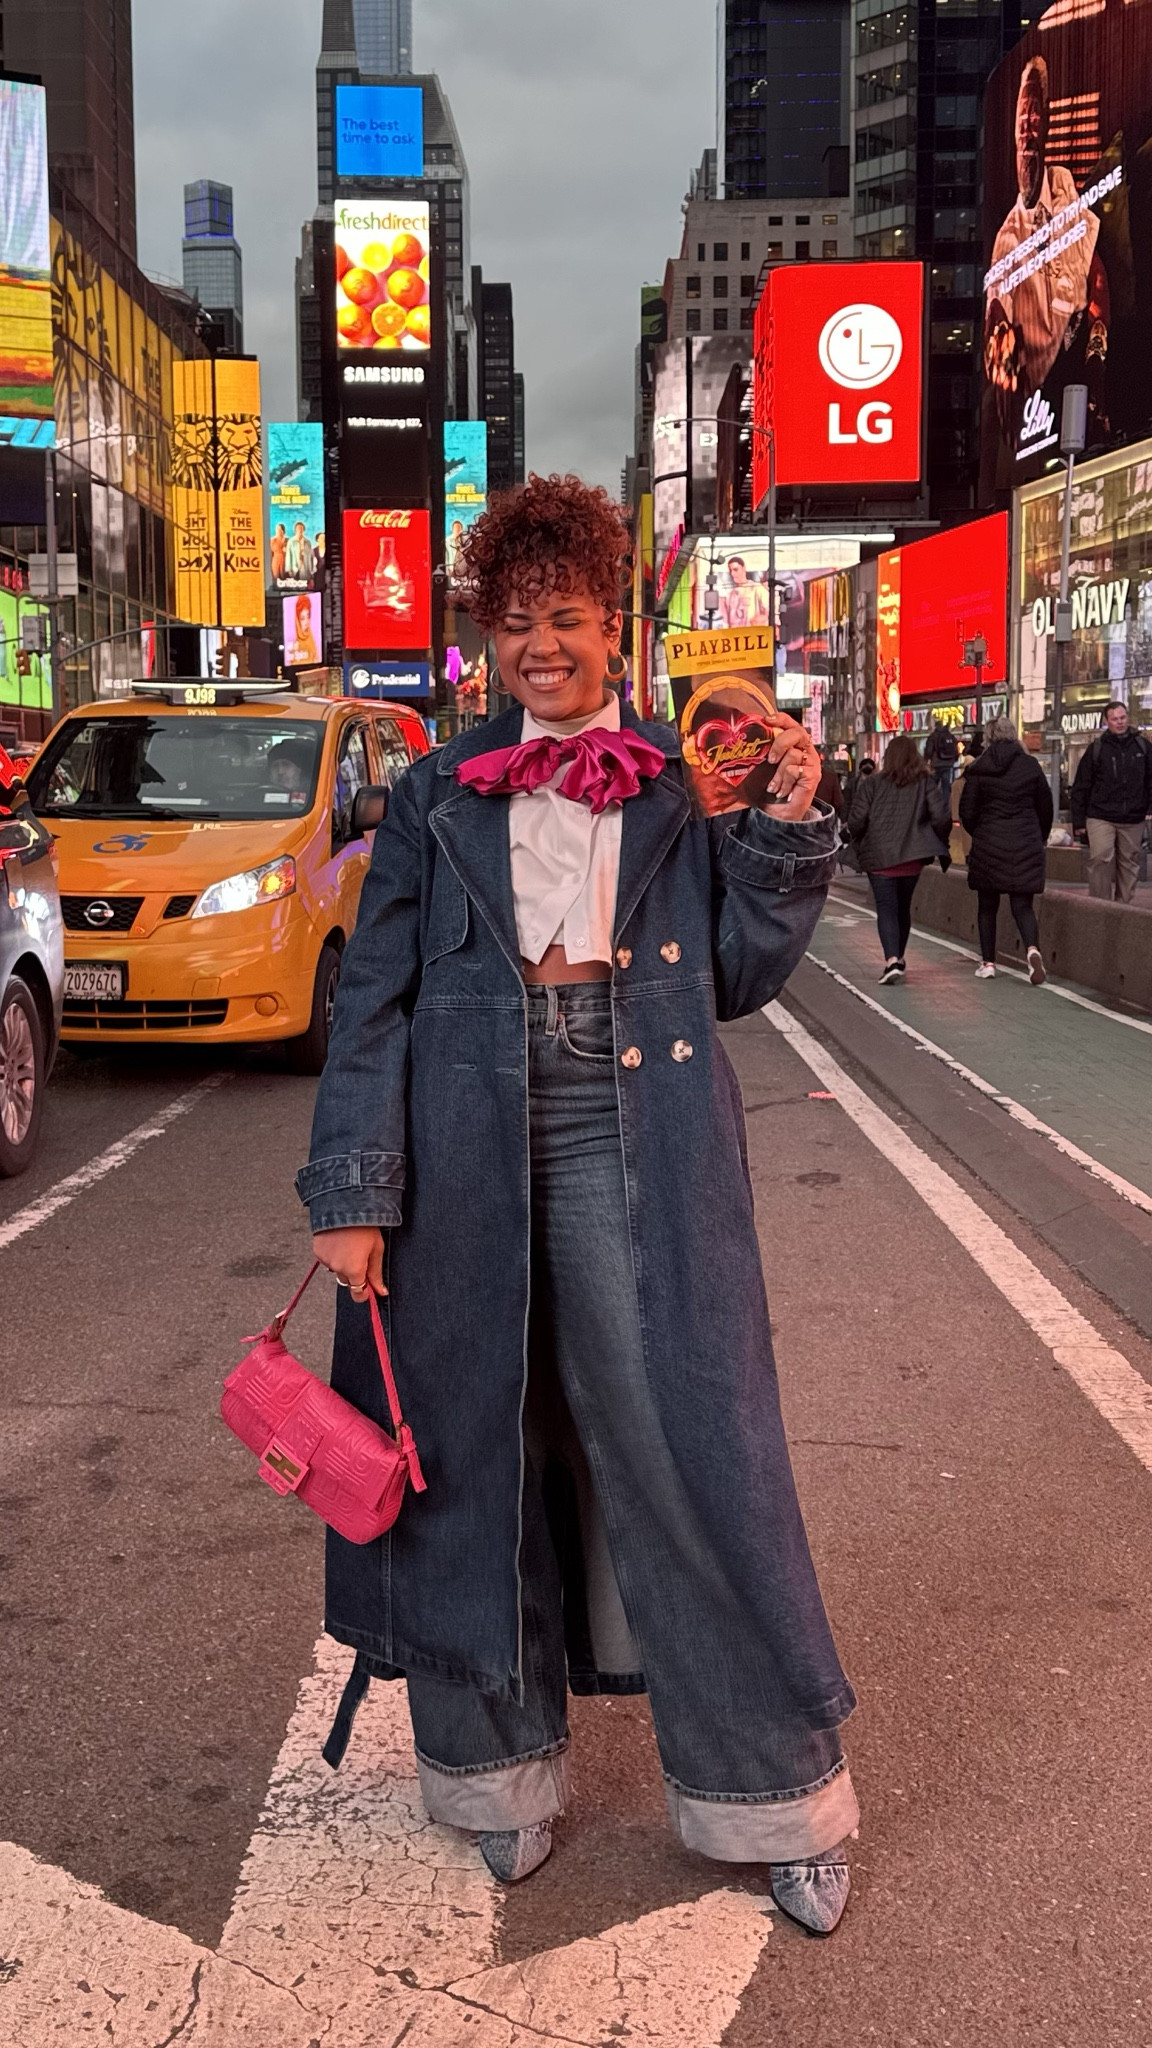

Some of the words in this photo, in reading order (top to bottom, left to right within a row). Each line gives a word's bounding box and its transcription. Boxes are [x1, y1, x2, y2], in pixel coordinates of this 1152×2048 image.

[342, 118, 366, 130] The
[370, 118, 399, 130] best
[343, 132, 372, 144] time
[374, 133, 389, 144] to
[392, 133, 415, 144] ask
[1098, 165, 1122, 198] SAVE
[338, 208, 427, 230] freshdirect
[344, 366, 424, 383] SAMSUNG
[347, 417, 366, 427] Visit
[366, 417, 406, 429] Samsung
[828, 401, 893, 444] LG
[1020, 389, 1055, 441] Lilly
[230, 517, 252, 527] THE
[227, 532, 256, 550] LION
[224, 552, 260, 573] KING
[1032, 596, 1060, 637] OL
[1072, 578, 1130, 631] NAVY
[672, 634, 769, 660] PLAYBILL
[371, 673, 421, 686] Prudential
[185, 688, 216, 704] 9J98
[912, 709, 929, 732] NY
[981, 701, 1002, 726] NY
[1061, 713, 1078, 734] OLD
[1078, 711, 1102, 731] NAVY
[700, 738, 772, 775] Juliet
[64, 972, 117, 991] 202967C
